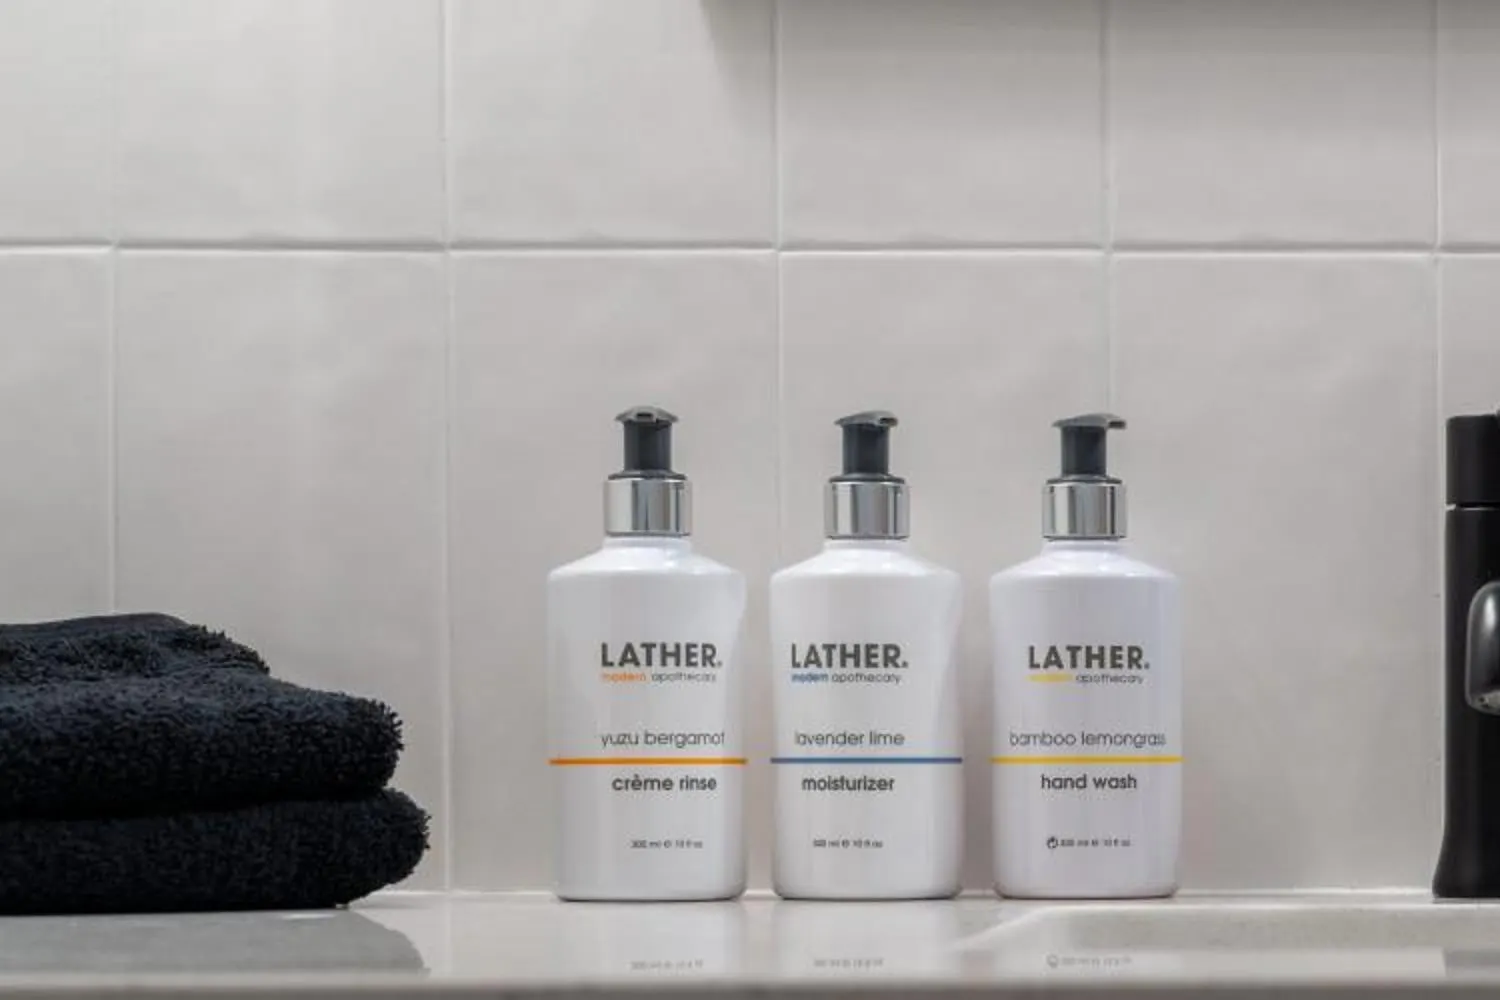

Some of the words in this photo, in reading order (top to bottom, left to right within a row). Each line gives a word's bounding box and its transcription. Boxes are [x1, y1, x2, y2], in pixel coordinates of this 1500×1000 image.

[832, 672, 901, 684] apothecary
[601, 732, 639, 748] yuzu
[644, 730, 725, 748] bergamot
[795, 731, 864, 746] lavender
[869, 731, 905, 746] lime
[1009, 731, 1077, 746] bamboo
[612, 773, 674, 791] crème
[679, 774, 717, 791] rinse
[802, 775, 895, 791] moisturizer
[1041, 773, 1087, 790] hand
[1093, 773, 1137, 790] wash
